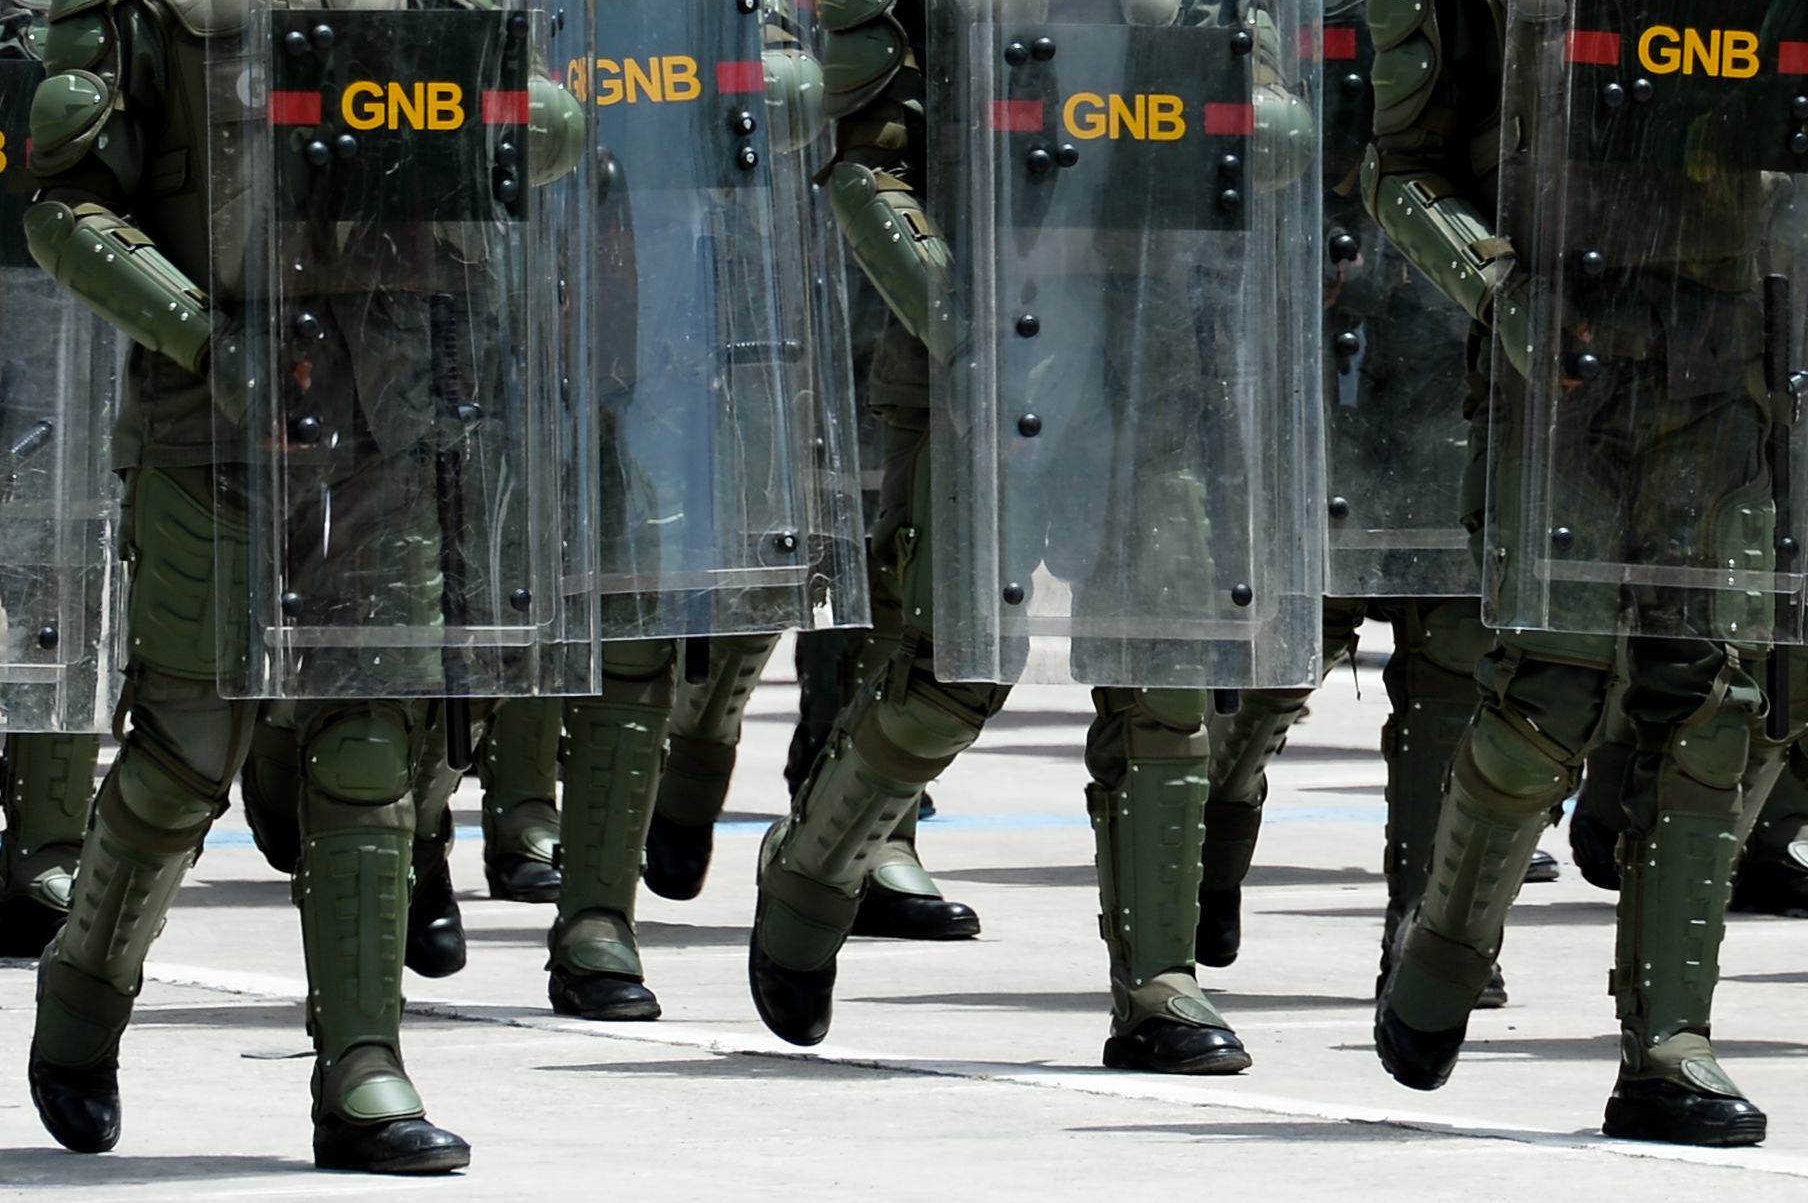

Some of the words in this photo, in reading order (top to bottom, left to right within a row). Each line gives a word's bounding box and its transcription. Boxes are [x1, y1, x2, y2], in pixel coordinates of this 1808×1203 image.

[1638, 25, 1760, 79] GNB
[342, 81, 465, 130] GNB
[597, 55, 702, 106] GNB
[1063, 92, 1186, 141] GNB
